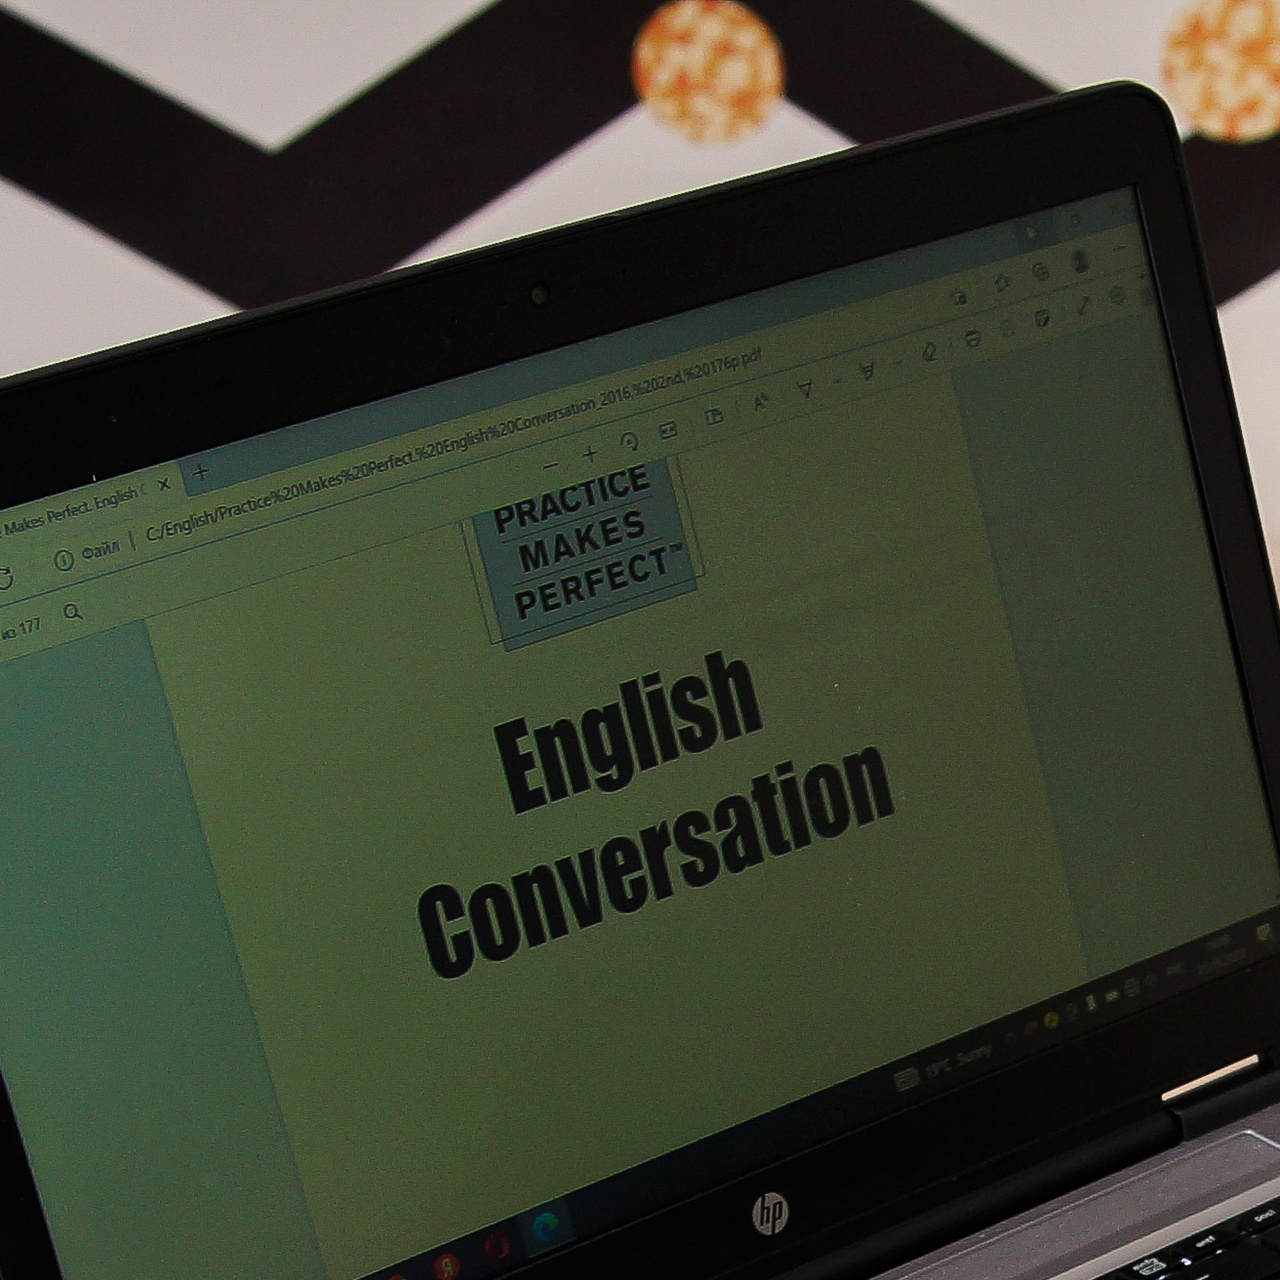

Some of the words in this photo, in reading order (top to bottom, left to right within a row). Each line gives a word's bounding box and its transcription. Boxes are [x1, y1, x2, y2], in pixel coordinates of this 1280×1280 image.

[4, 516, 45, 537] Makes
[93, 487, 138, 511] English
[493, 464, 650, 535] PRACTICE
[81, 541, 121, 561] Файл
[518, 510, 646, 573] MAKES
[19, 617, 42, 635] 177
[493, 649, 763, 816] English
[417, 746, 895, 980] Conversation
[755, 1193, 786, 1235] hp
